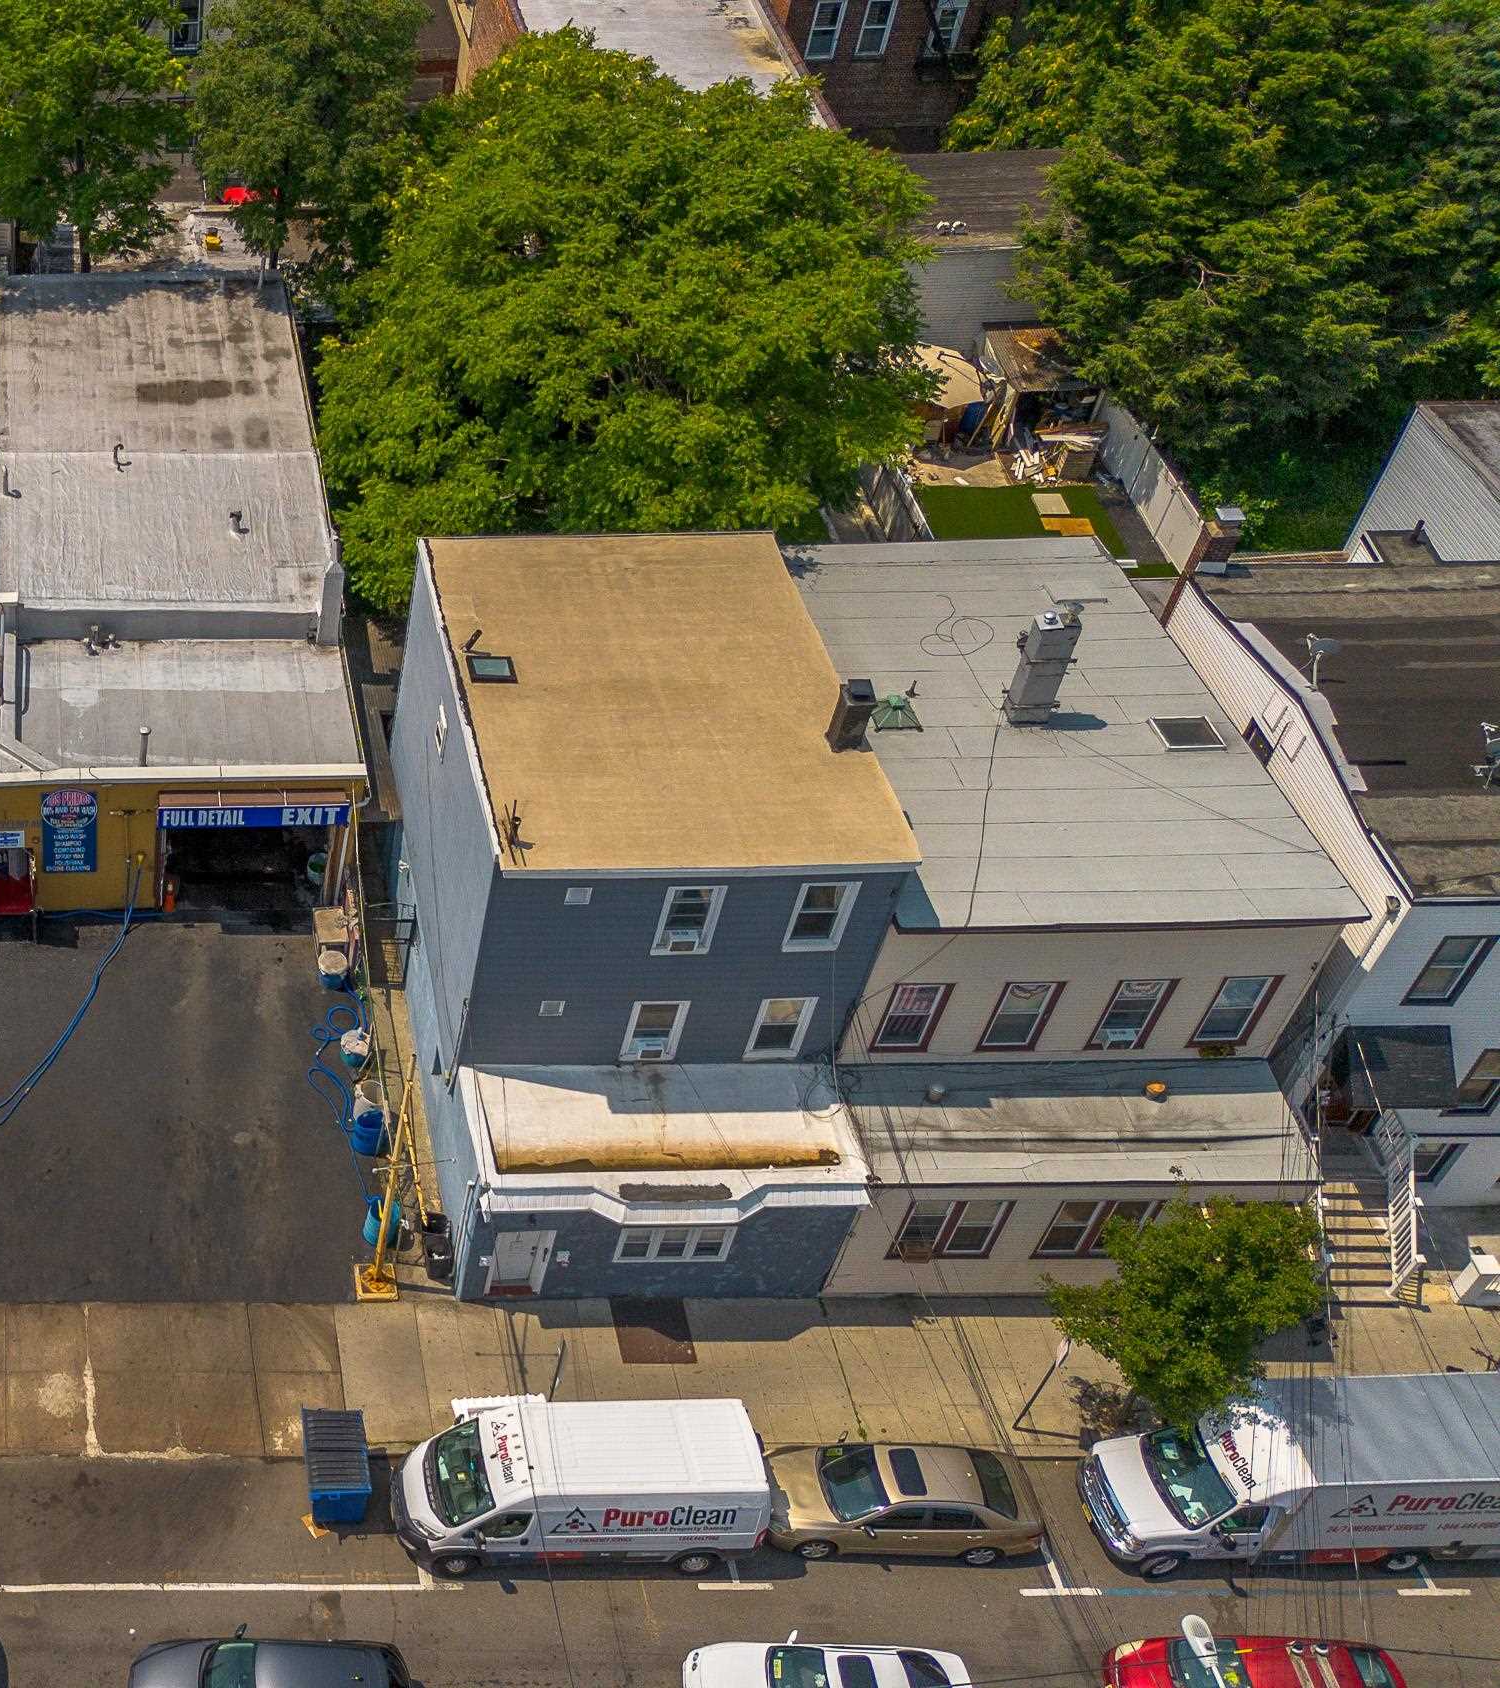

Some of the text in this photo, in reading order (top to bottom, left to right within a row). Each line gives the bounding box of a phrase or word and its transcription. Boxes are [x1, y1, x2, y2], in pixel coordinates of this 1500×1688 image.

[162, 809, 245, 827] FULL DETAIL
[281, 807, 341, 826] EXIT
[497, 1435, 514, 1484] PuroClean
[1220, 1430, 1257, 1490] PuroClean
[602, 1505, 737, 1528] PuroClean
